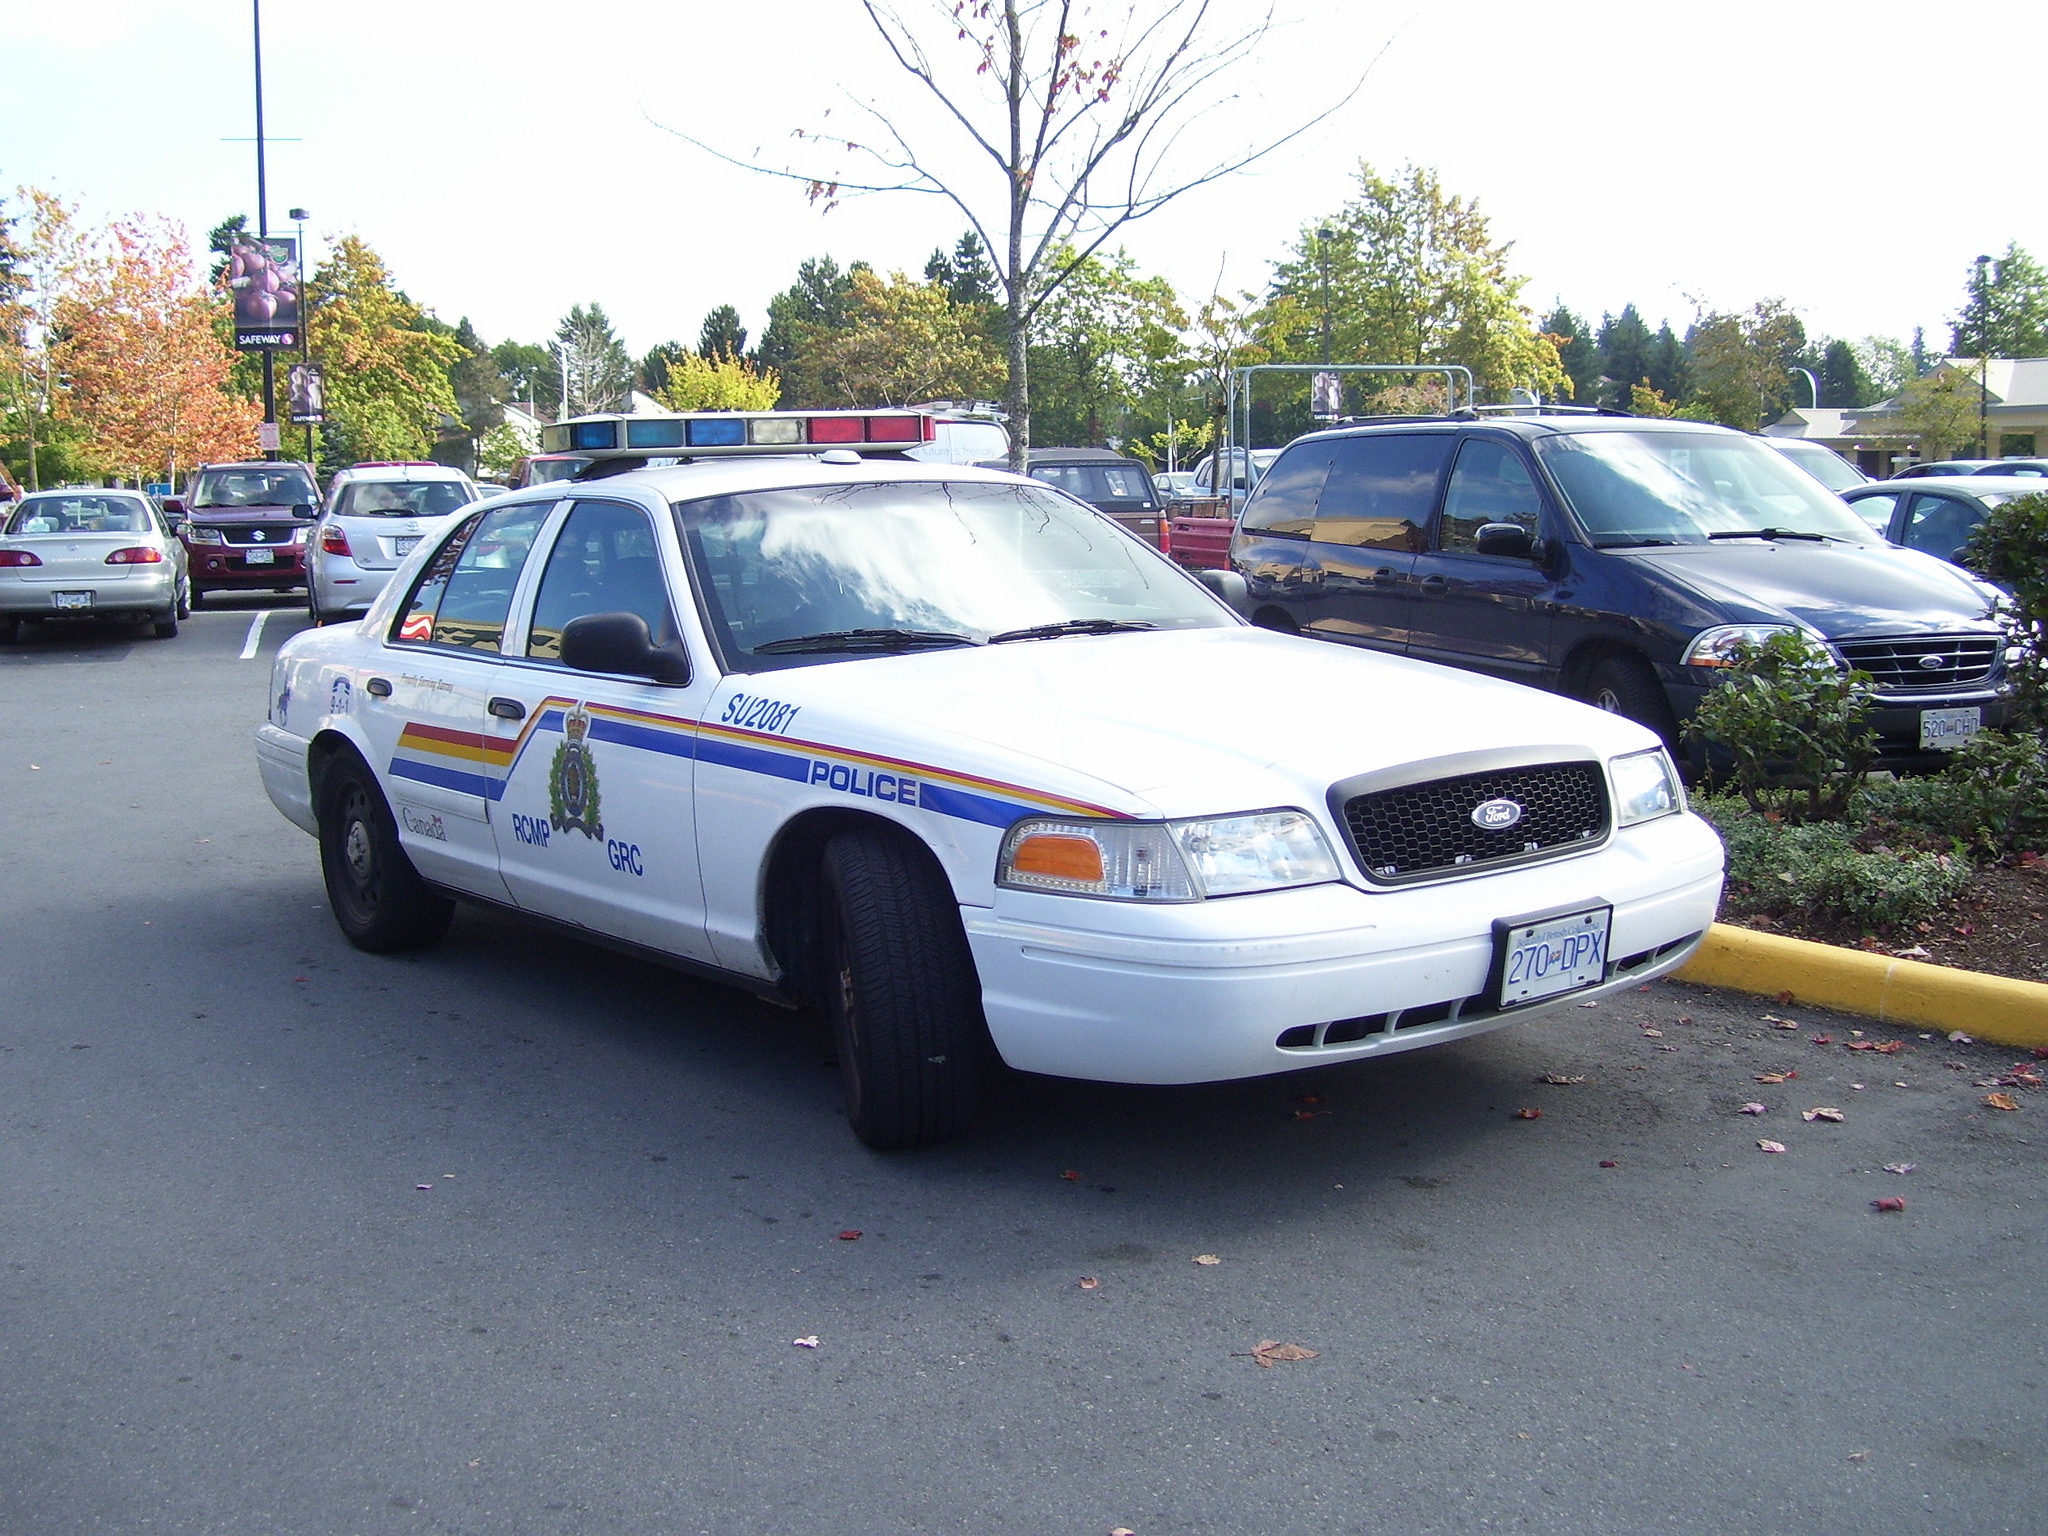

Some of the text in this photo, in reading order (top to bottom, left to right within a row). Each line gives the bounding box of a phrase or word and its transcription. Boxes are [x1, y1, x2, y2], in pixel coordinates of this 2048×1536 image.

[239, 334, 281, 345] SAFEWAY
[721, 692, 802, 735] SU2081
[1922, 719, 1946, 738] 520
[810, 760, 916, 807] POLICE
[402, 806, 448, 842] Canada
[1485, 805, 1510, 822] Ford
[512, 813, 643, 877] RCMP GRC
[1508, 930, 1604, 985] 270 DPX
